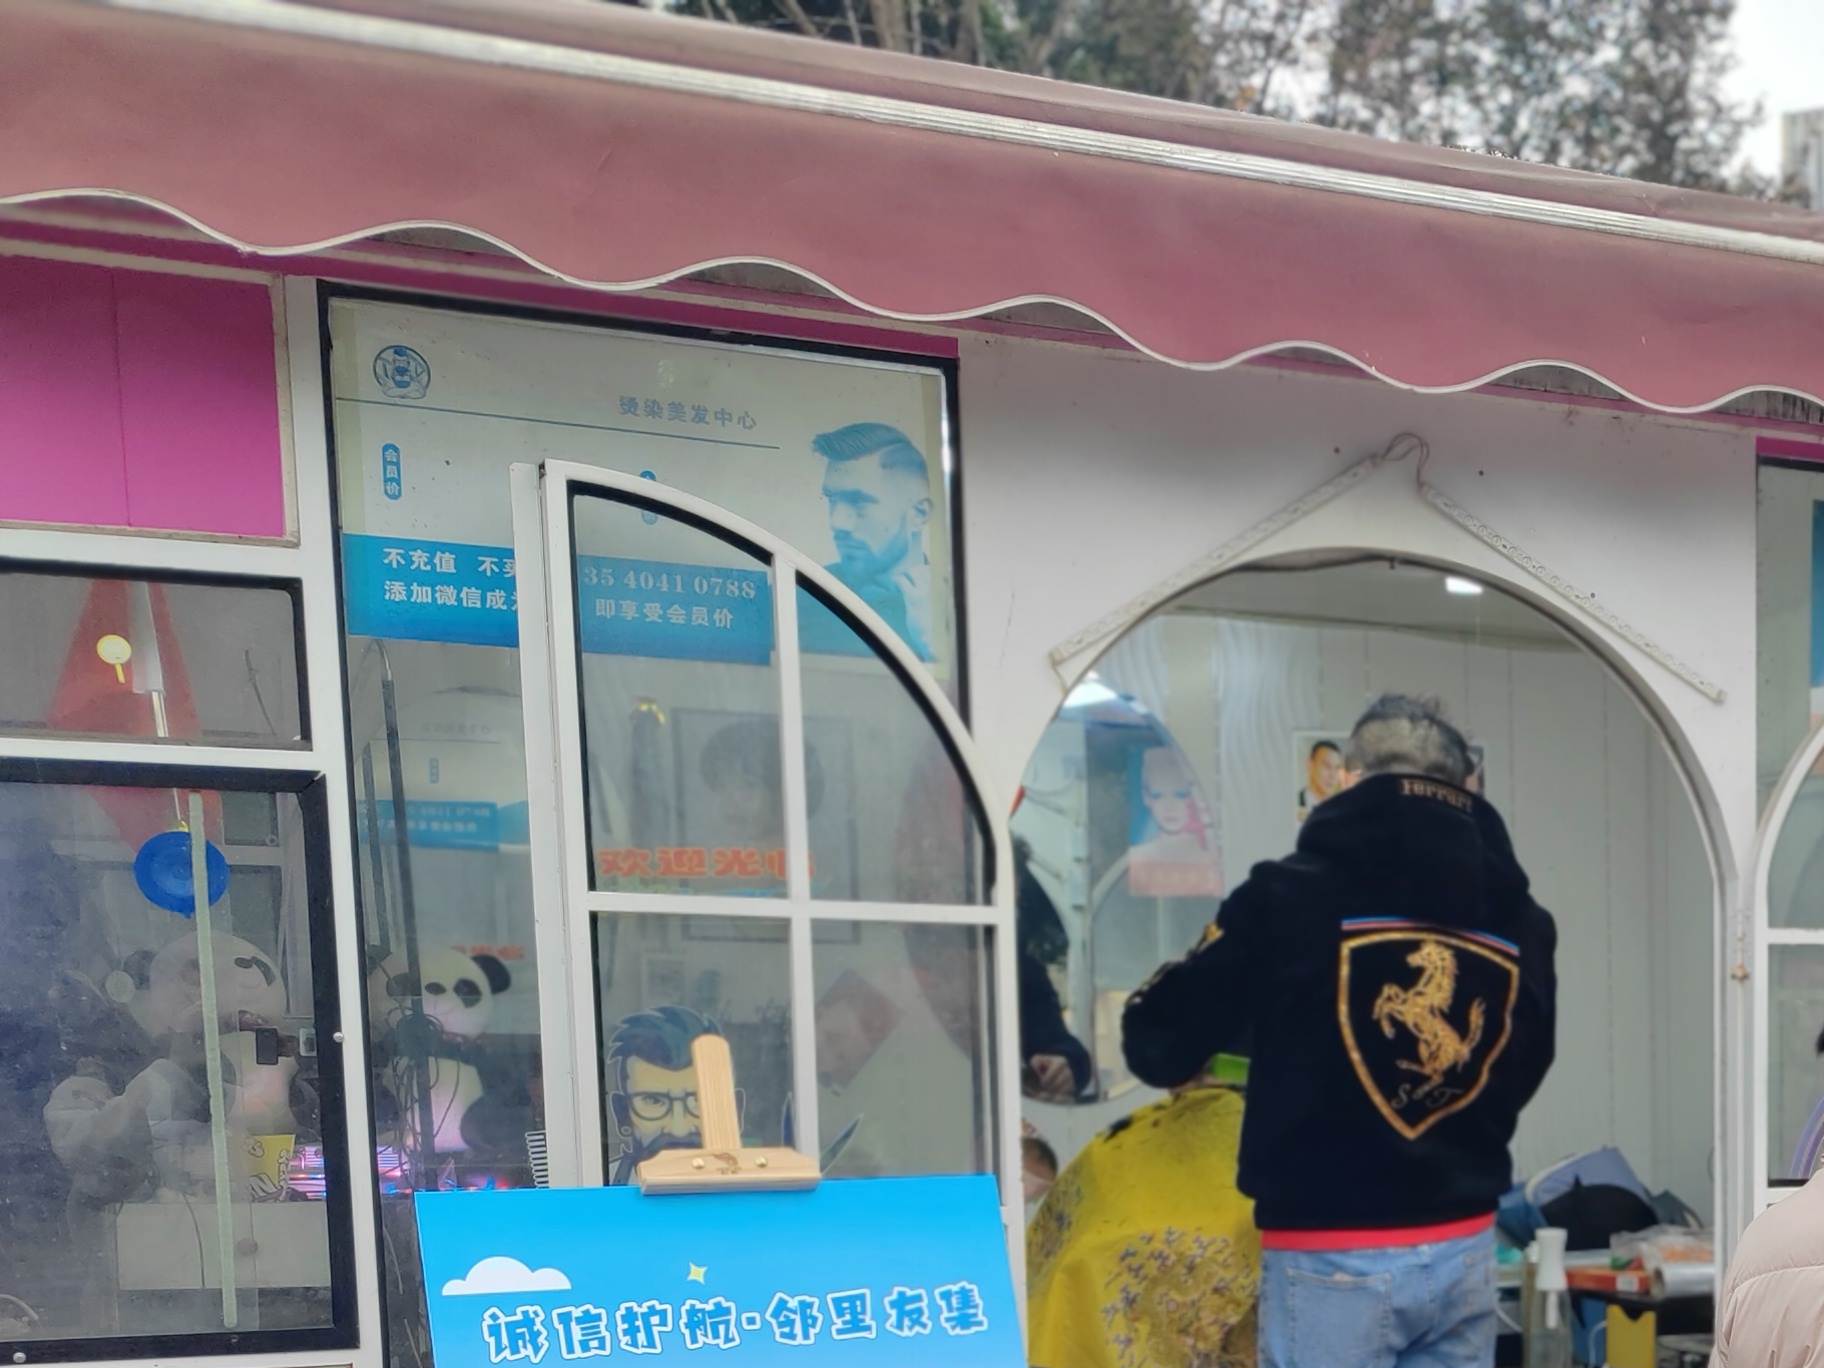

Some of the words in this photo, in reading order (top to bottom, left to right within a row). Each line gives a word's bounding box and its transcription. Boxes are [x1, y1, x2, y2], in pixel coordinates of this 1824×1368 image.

[619, 395, 757, 430] 烫染美发中心
[384, 449, 400, 496] 会员价
[383, 547, 457, 574] 不充值
[384, 580, 518, 611] 添加微信成
[583, 566, 614, 586] 35
[624, 570, 685, 593] 4041
[694, 575, 756, 599] 0788
[596, 599, 733, 629] 即享受会员价
[482, 1281, 989, 1363] 诚信护航·邻里友集
